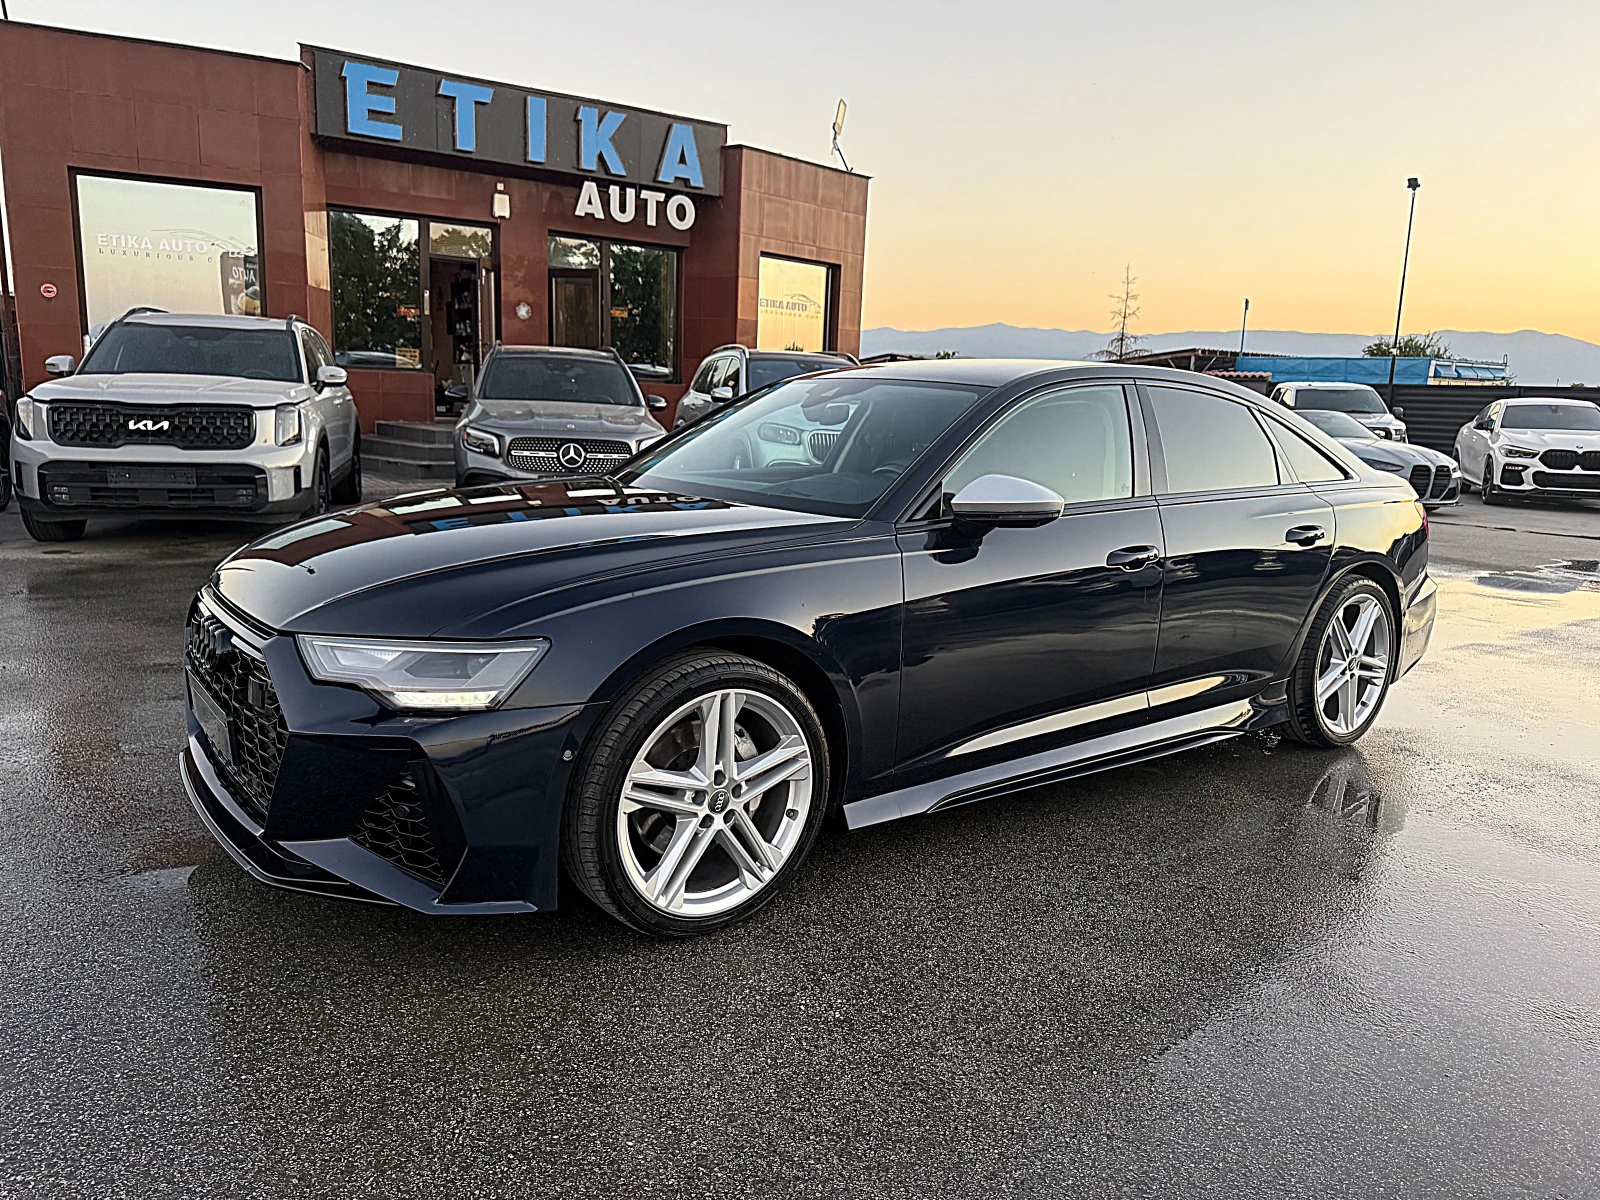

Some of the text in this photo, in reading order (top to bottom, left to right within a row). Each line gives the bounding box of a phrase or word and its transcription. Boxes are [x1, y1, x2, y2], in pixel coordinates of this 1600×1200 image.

[341, 60, 704, 188] ETIKA
[574, 181, 696, 231] AUTO
[97, 233, 208, 254] ETIKA AUTO
[99, 248, 193, 261] LUXURIOUS
[760, 298, 808, 312] ETIKA AUTO
[128, 419, 170, 431] KIA
